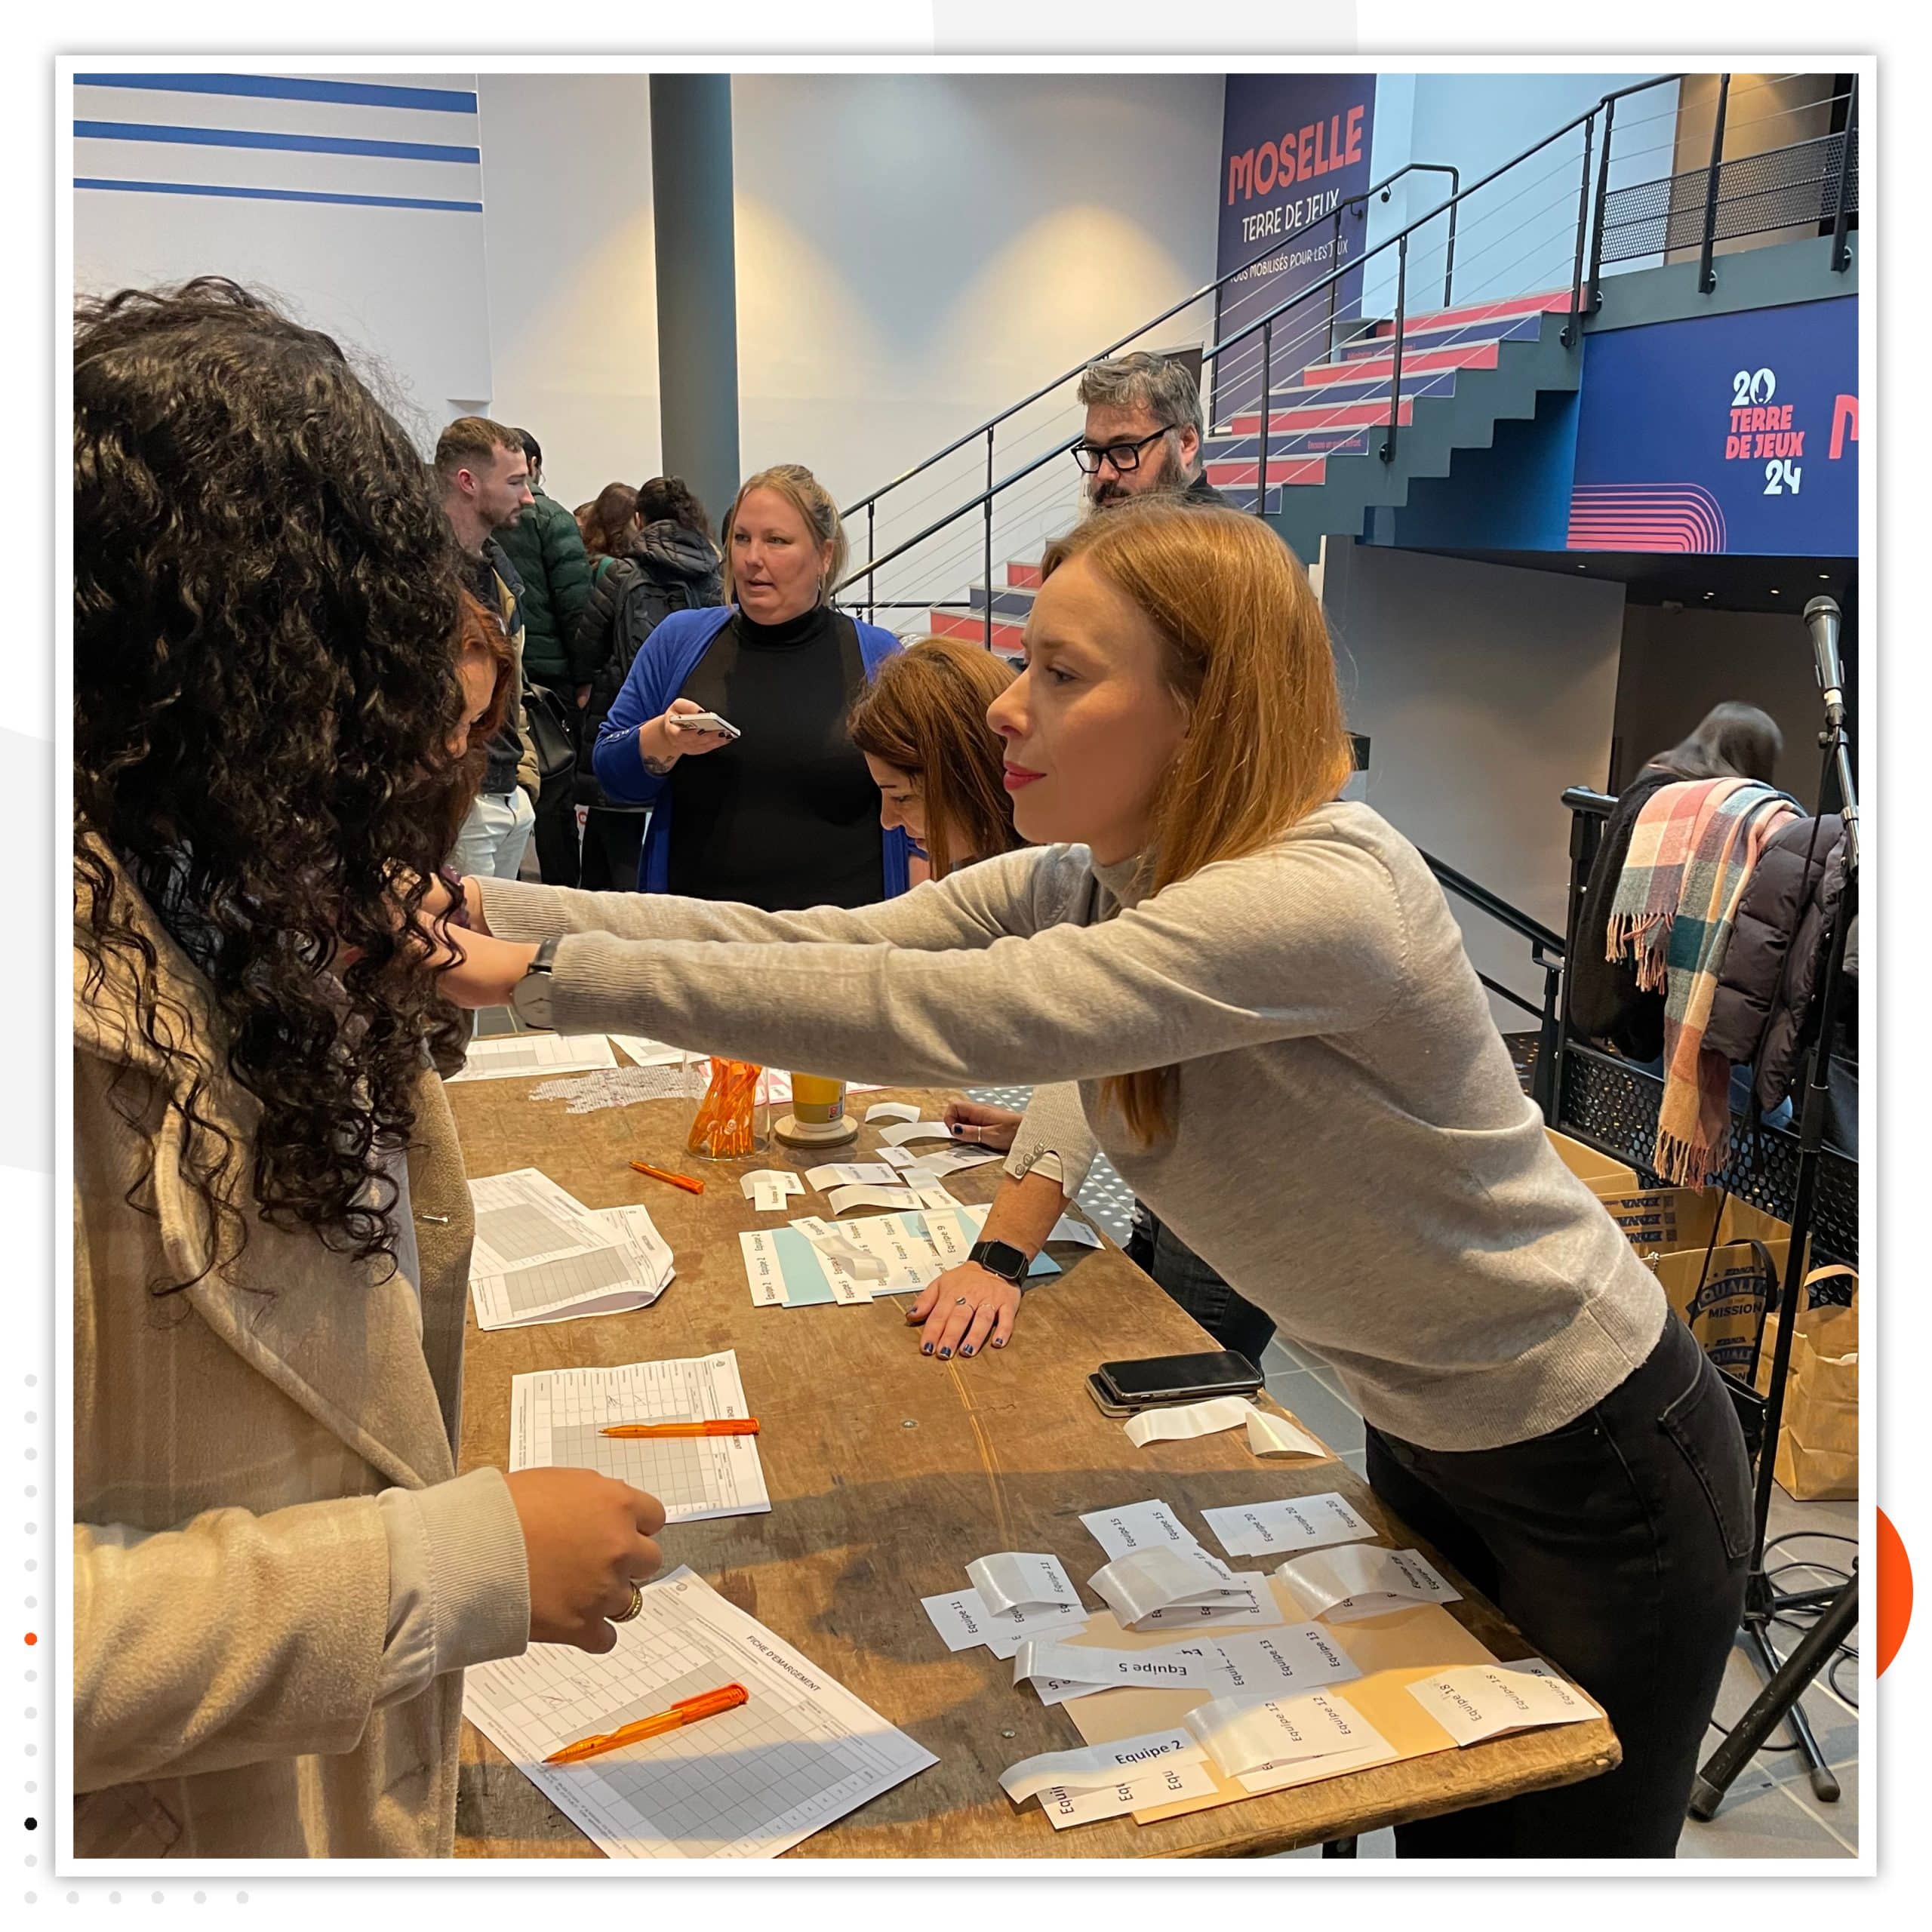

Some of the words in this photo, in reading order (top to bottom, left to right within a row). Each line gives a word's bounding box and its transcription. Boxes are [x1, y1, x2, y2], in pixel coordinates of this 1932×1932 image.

[1228, 104, 1364, 205] MOSELLE
[1242, 207, 1281, 243] TERRE
[1285, 200, 1303, 231] DE
[1250, 252, 1288, 278] MOBILISÉS
[1290, 250, 1312, 269] POUR
[1313, 244, 1327, 262] LES
[1328, 238, 1348, 257] JUX
[1731, 368, 1776, 406] 20
[1730, 405, 1793, 432] TERRE
[1726, 435, 1750, 460] DE
[1754, 431, 1804, 458] JEUX
[1764, 459, 1801, 494] 24
[941, 1232, 956, 1254] Equipe
[1708, 1303, 1762, 1318] MISSION
[1286, 1506, 1297, 1515] 20
[1326, 1500, 1338, 1508] 20
[1244, 1513, 1257, 1521] 20
[1294, 1514, 1315, 1535] Equipe
[1337, 1507, 1357, 1527] Equipe
[1118, 1527, 1137, 1547] Equipe
[1161, 1520, 1179, 1540] Equipe
[1254, 1521, 1273, 1542] Equipe
[1040, 1561, 1051, 1570] 11
[1047, 1571, 1063, 1593] Equipe
[951, 1601, 963, 1610] 11
[958, 1611, 979, 1634] Equipe
[746, 1635, 770, 1653] FICHE
[1260, 1640, 1273, 1649] 13
[1306, 1631, 1319, 1641] 13
[1269, 1650, 1294, 1677] Equipe
[1317, 1641, 1341, 1668] Equipe
[1118, 1663, 1128, 1672] 5
[1133, 1663, 1187, 1676] Equipe
[1439, 1684, 1455, 1694] 18
[1486, 1674, 1500, 1683] 18
[1313, 1696, 1327, 1706] 12
[1499, 1684, 1529, 1710] Equipe
[1545, 1679, 1575, 1706] Equipe
[1265, 1702, 1279, 1712] 12
[1453, 1694, 1482, 1721] Equipe
[1276, 1713, 1302, 1742] Equipe
[1324, 1707, 1351, 1735] Equipe
[1114, 1745, 1170, 1764] Equipe
[1171, 1740, 1183, 1749] 2
[1162, 1770, 1183, 1791] Equ
